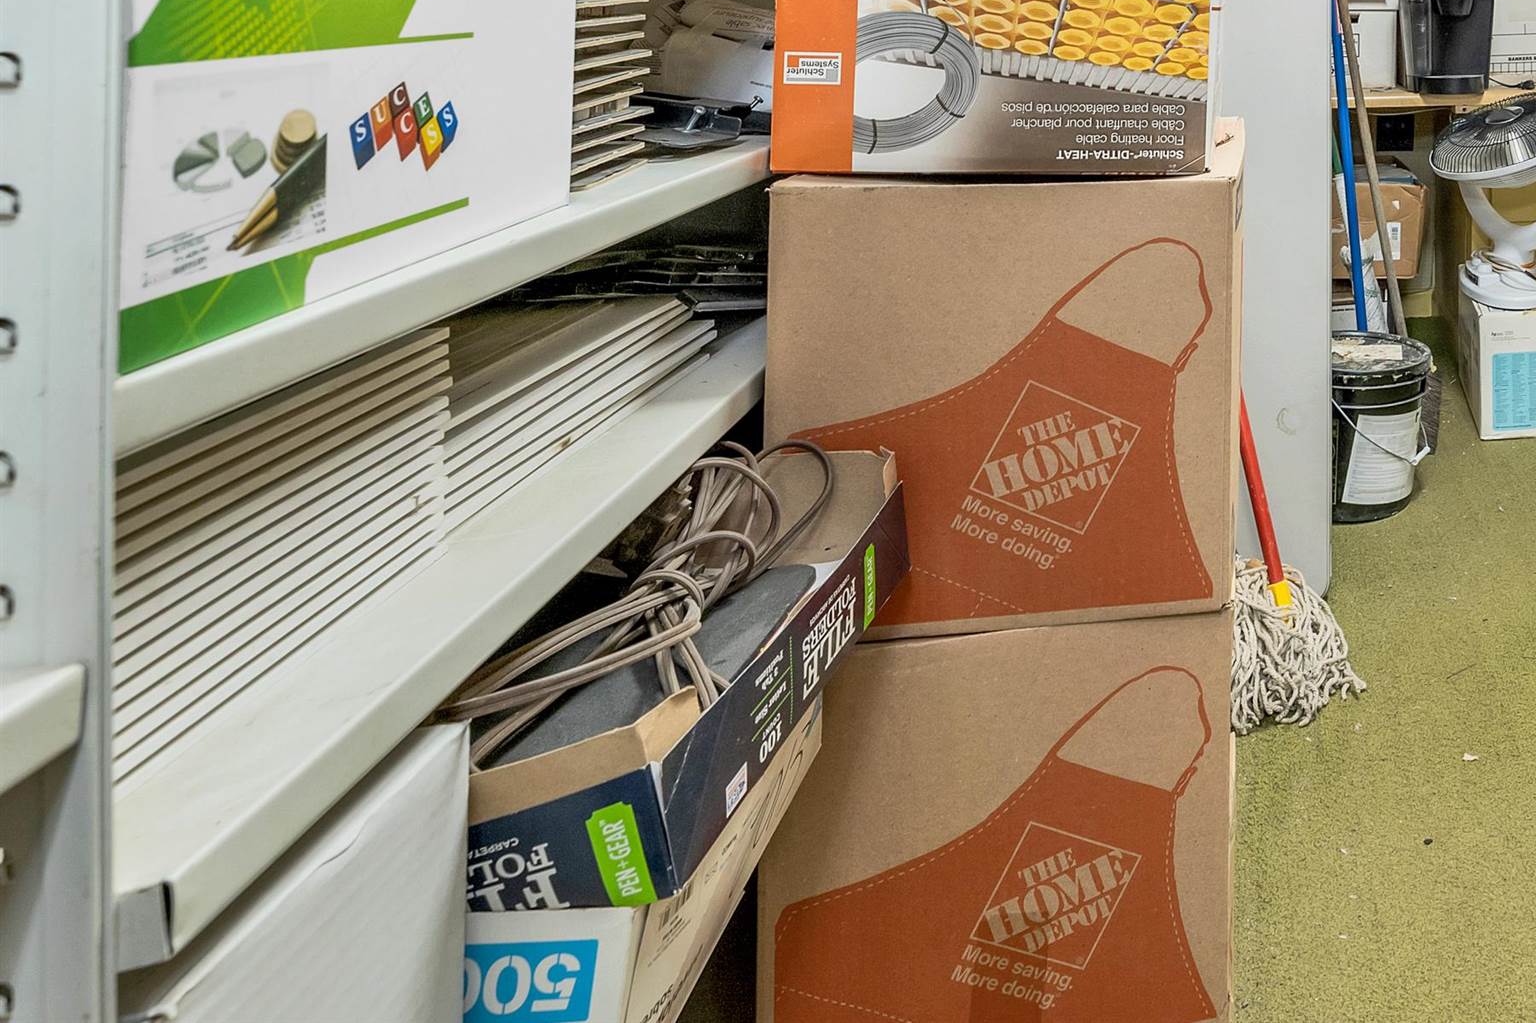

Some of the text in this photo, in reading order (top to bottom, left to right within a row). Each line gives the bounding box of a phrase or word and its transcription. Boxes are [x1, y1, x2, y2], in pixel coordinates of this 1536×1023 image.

[786, 67, 824, 77] Schluter
[800, 59, 839, 69] Systems
[1001, 102, 1185, 115] Cable para calefacción de pisos
[1010, 118, 1185, 131] Câble chauffant pour plancher
[1076, 133, 1184, 145] Floor heating cable
[1017, 411, 1076, 447] THE
[983, 418, 1129, 498] HOME
[1022, 462, 1111, 512] DEPOT
[950, 514, 1055, 570] More doing.
[961, 495, 1072, 553] More saving.
[802, 576, 857, 660] FOLDERS
[803, 598, 856, 701] FILE
[760, 720, 782, 764] 100
[1017, 848, 1077, 887] THE
[984, 849, 1130, 944] HOME
[1023, 894, 1112, 953] DEPOT
[951, 964, 1056, 1010] More doing.
[961, 944, 1073, 991] More saving.
